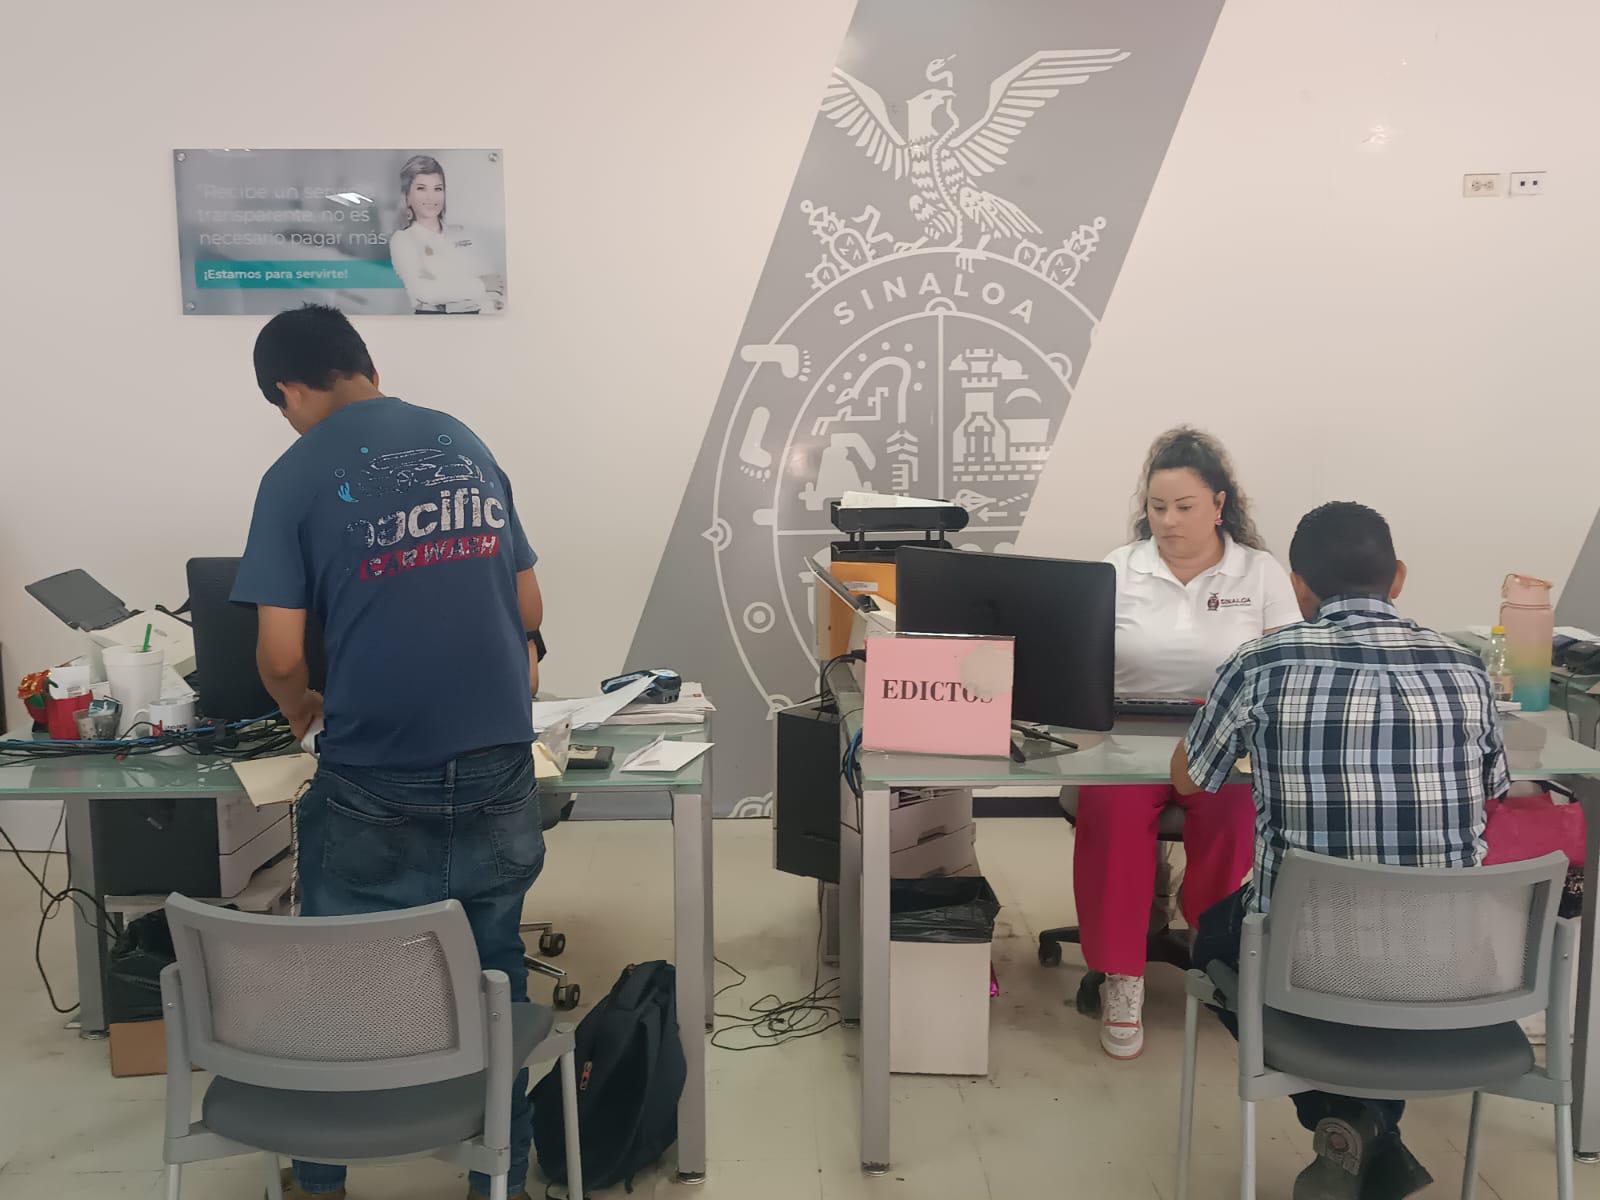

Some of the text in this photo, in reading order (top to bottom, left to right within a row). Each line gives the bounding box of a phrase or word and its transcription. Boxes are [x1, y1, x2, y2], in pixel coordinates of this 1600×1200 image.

[274, 186, 299, 200] un
[322, 209, 345, 222] no
[350, 209, 370, 222] es
[291, 232, 341, 248] pagar
[265, 270, 293, 281] para
[296, 268, 349, 280] servirte!
[833, 272, 1034, 325] SINALOA
[881, 678, 993, 704] EDICTO
